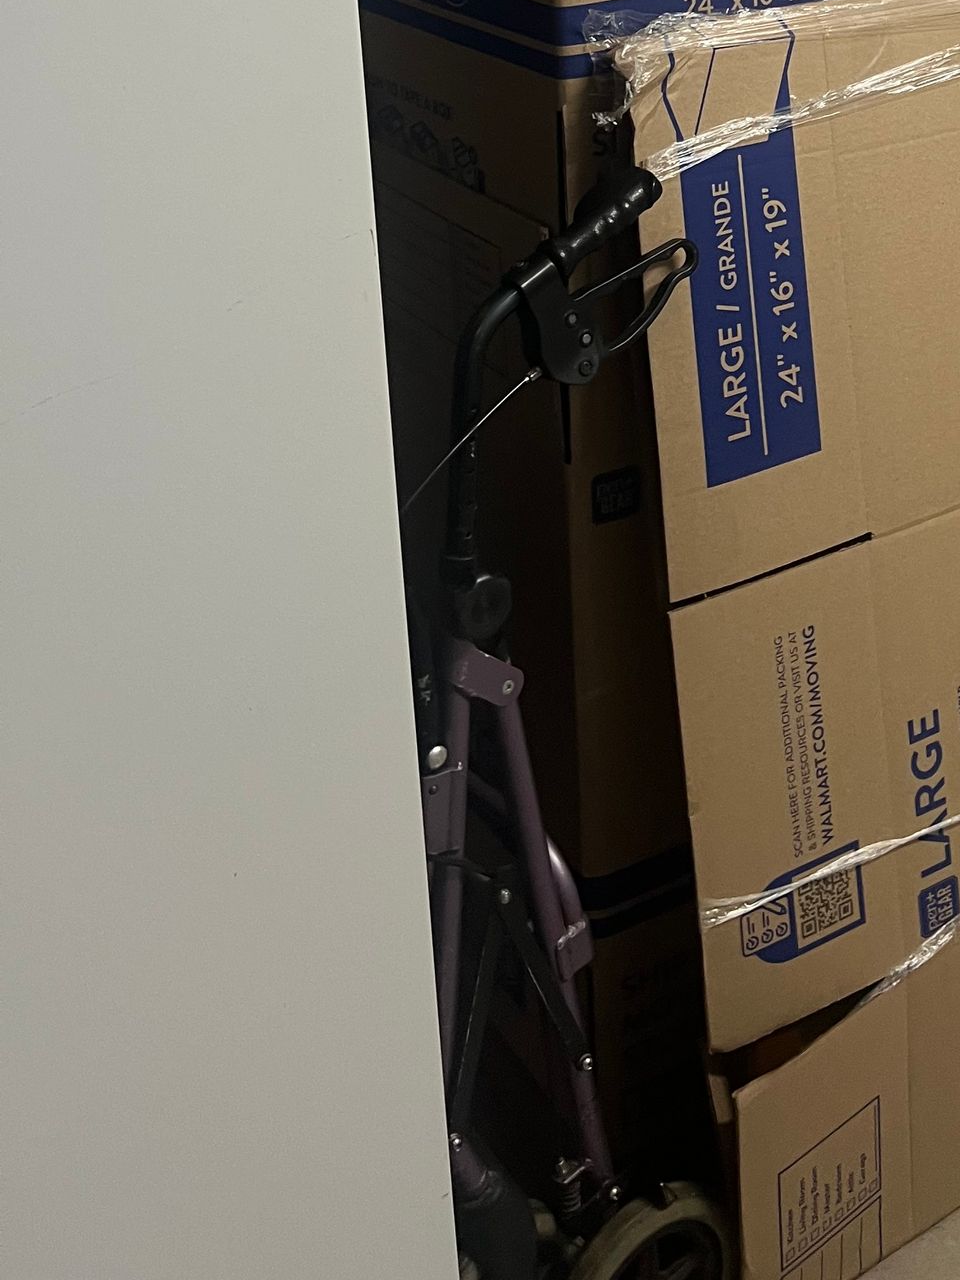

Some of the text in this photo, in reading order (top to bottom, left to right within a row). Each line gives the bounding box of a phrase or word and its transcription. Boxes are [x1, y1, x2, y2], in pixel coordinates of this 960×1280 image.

[711, 180, 751, 442] LARGE / GRANDE
[761, 187, 804, 409] 24" x 16" x 19"
[773, 635, 803, 858] SCAN HERE FOR ADDITIONAL PACKING
[787, 631, 817, 851] & SHIPPING RESOURCES OR VISIT US AT
[802, 624, 834, 846] WALMART.COM/MOVING
[907, 708, 952, 878] LARGE
[937, 884, 954, 921] GEAR
